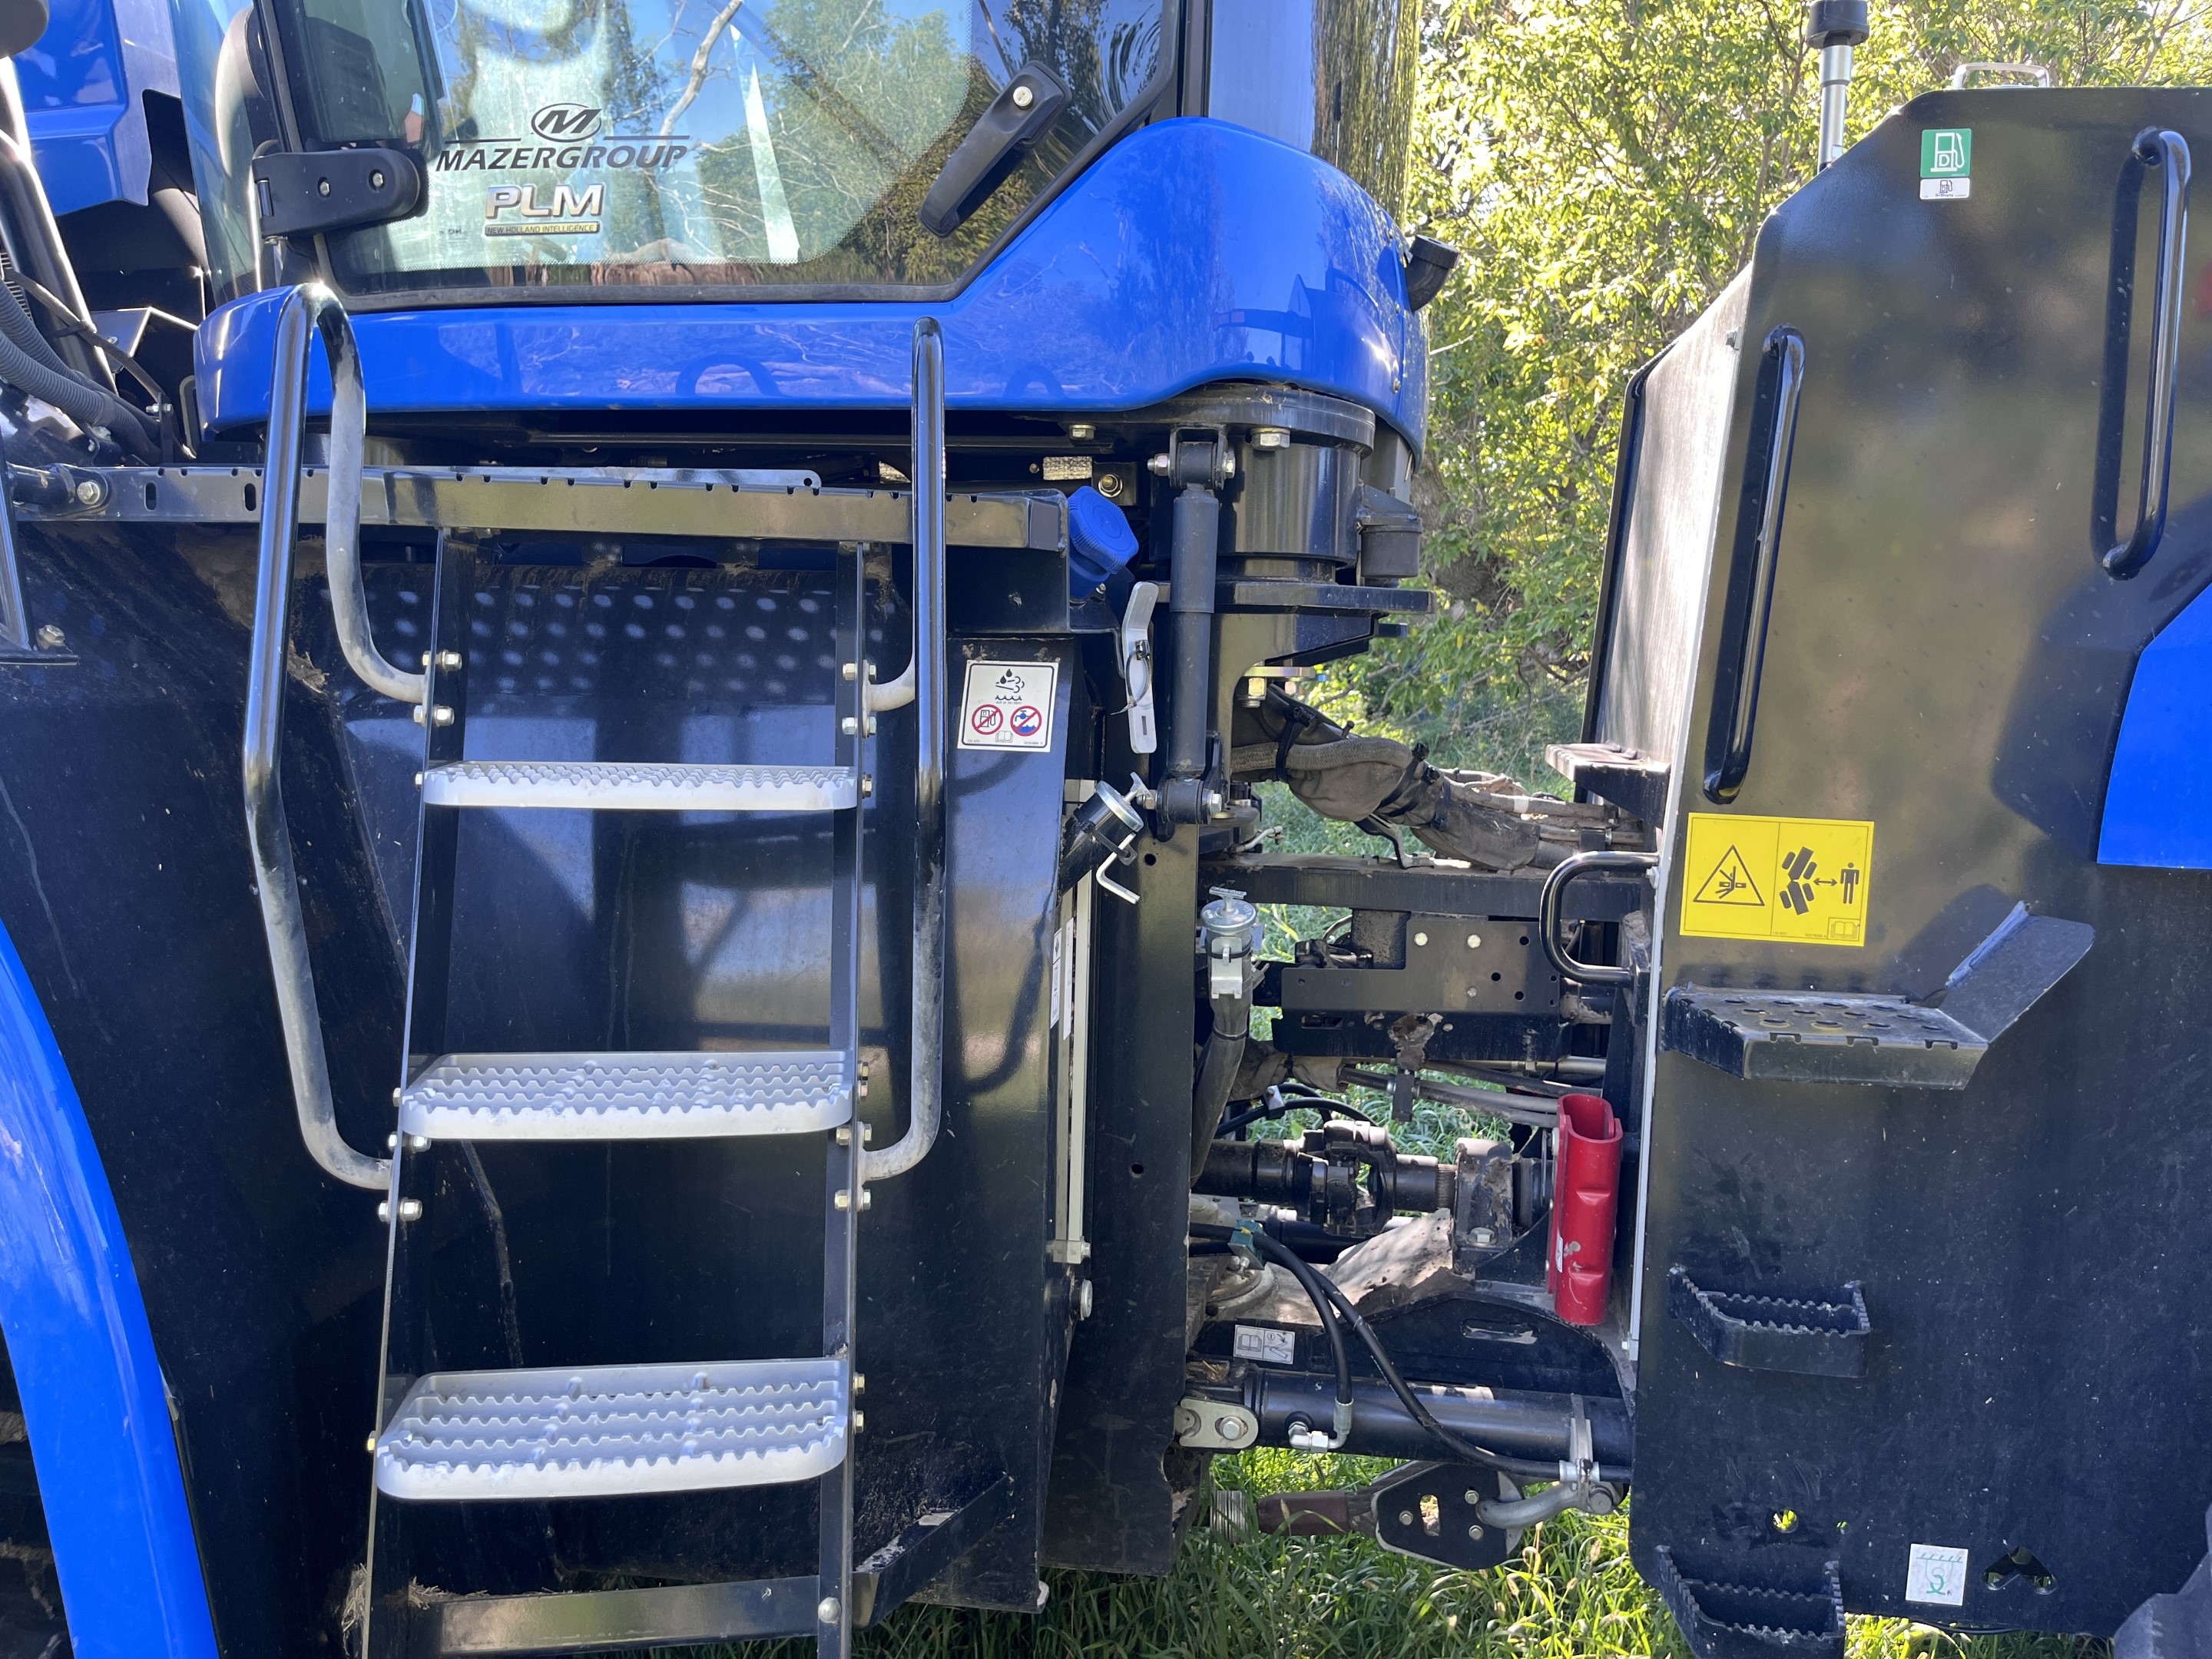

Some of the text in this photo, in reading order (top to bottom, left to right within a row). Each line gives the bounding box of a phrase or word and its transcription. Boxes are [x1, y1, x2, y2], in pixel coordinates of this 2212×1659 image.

[538, 108, 603, 134] M
[435, 145, 688, 171] MAZERGROUP
[1939, 154, 1950, 167] D
[485, 184, 604, 219] PLM
[542, 224, 594, 233] INTELLIGENCE
